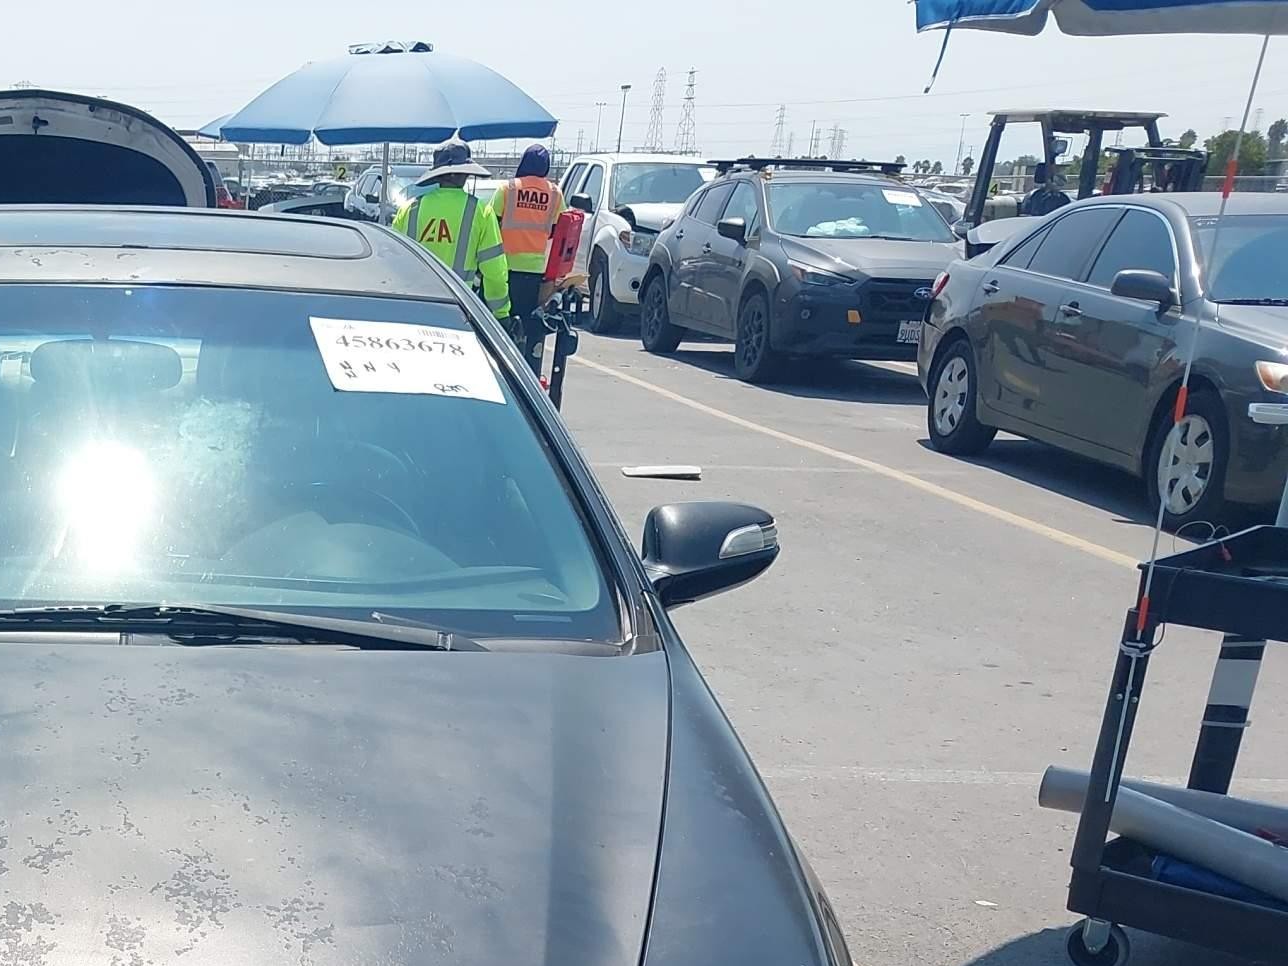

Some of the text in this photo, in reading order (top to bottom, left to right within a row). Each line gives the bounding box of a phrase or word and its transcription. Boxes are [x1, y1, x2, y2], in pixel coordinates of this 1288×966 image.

[338, 167, 346, 180] 2
[989, 183, 999, 195] 4
[517, 189, 549, 205] MAD
[335, 334, 465, 356] 45863678
